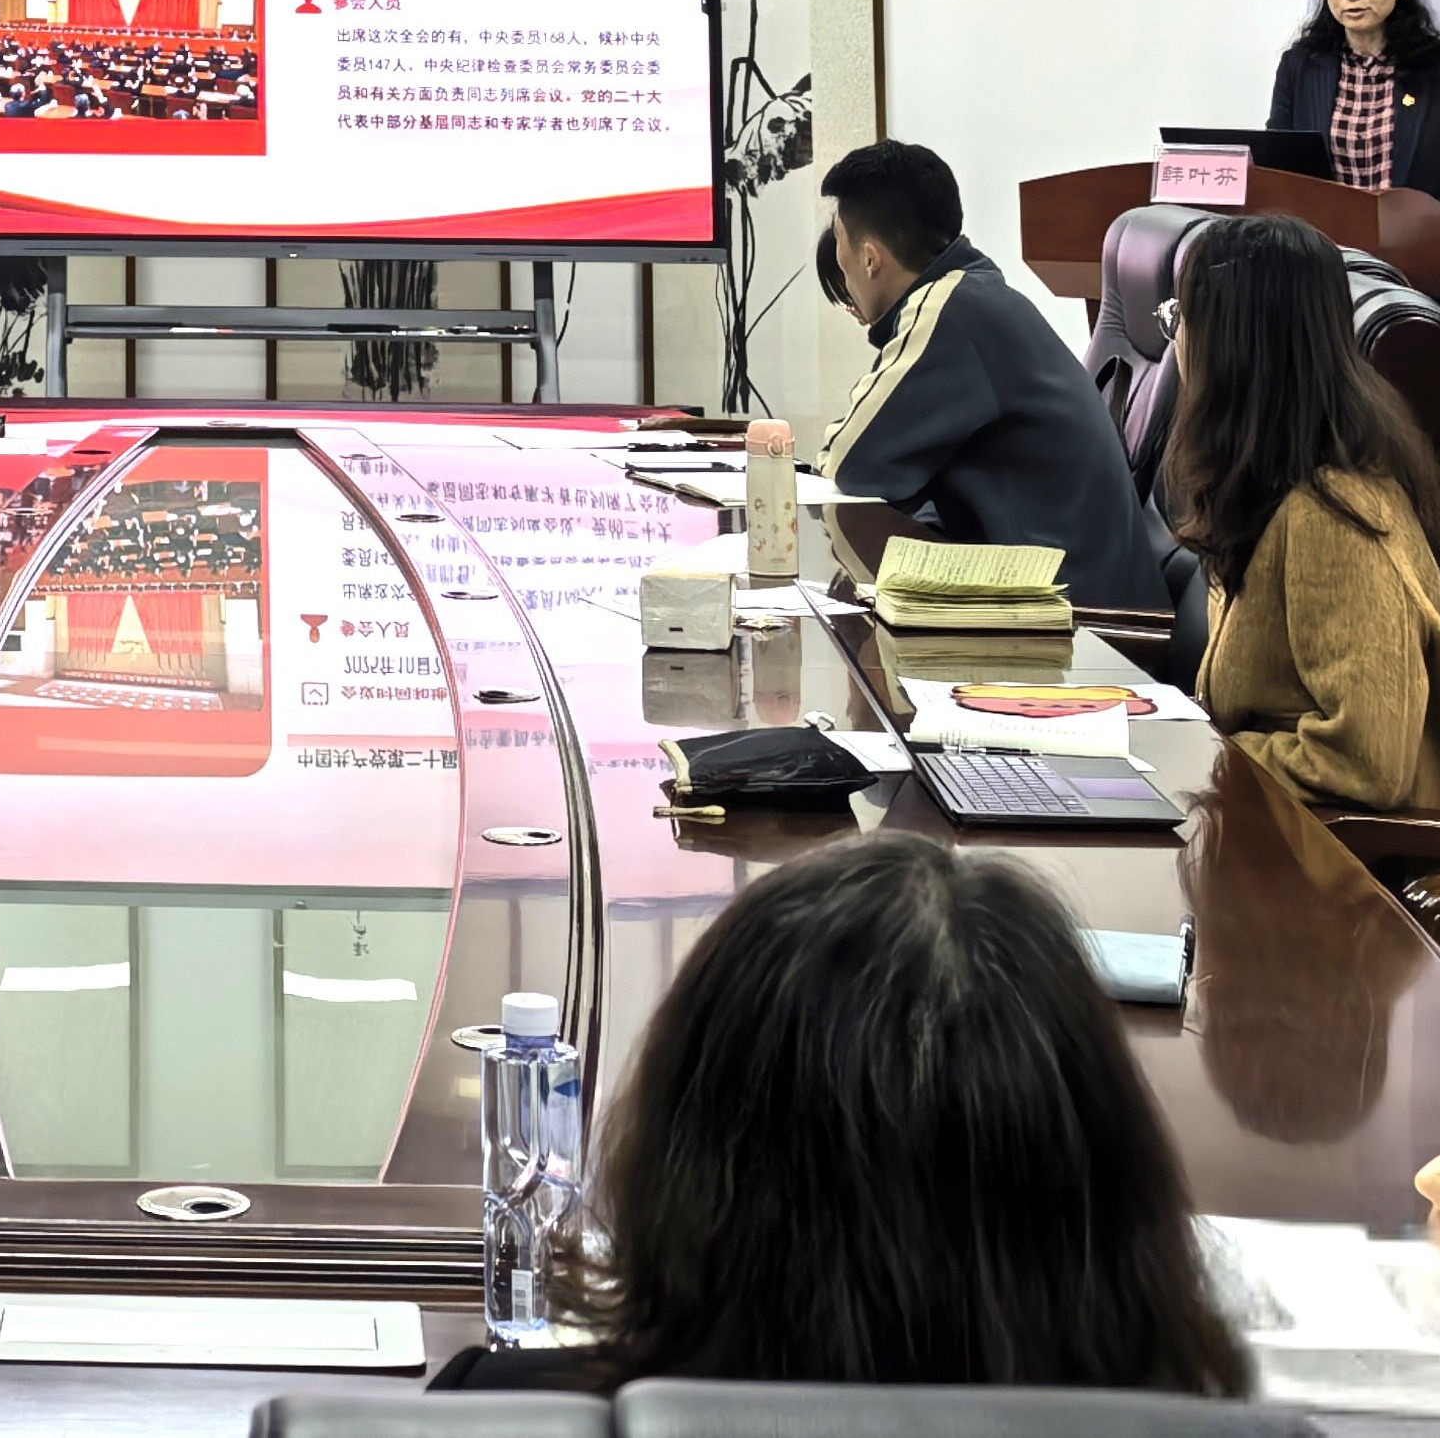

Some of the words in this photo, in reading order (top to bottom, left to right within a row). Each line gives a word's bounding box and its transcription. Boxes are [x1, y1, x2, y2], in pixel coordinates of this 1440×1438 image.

[337, 87, 663, 104] 员和有关方面负责同志列席会议。党的二十大
